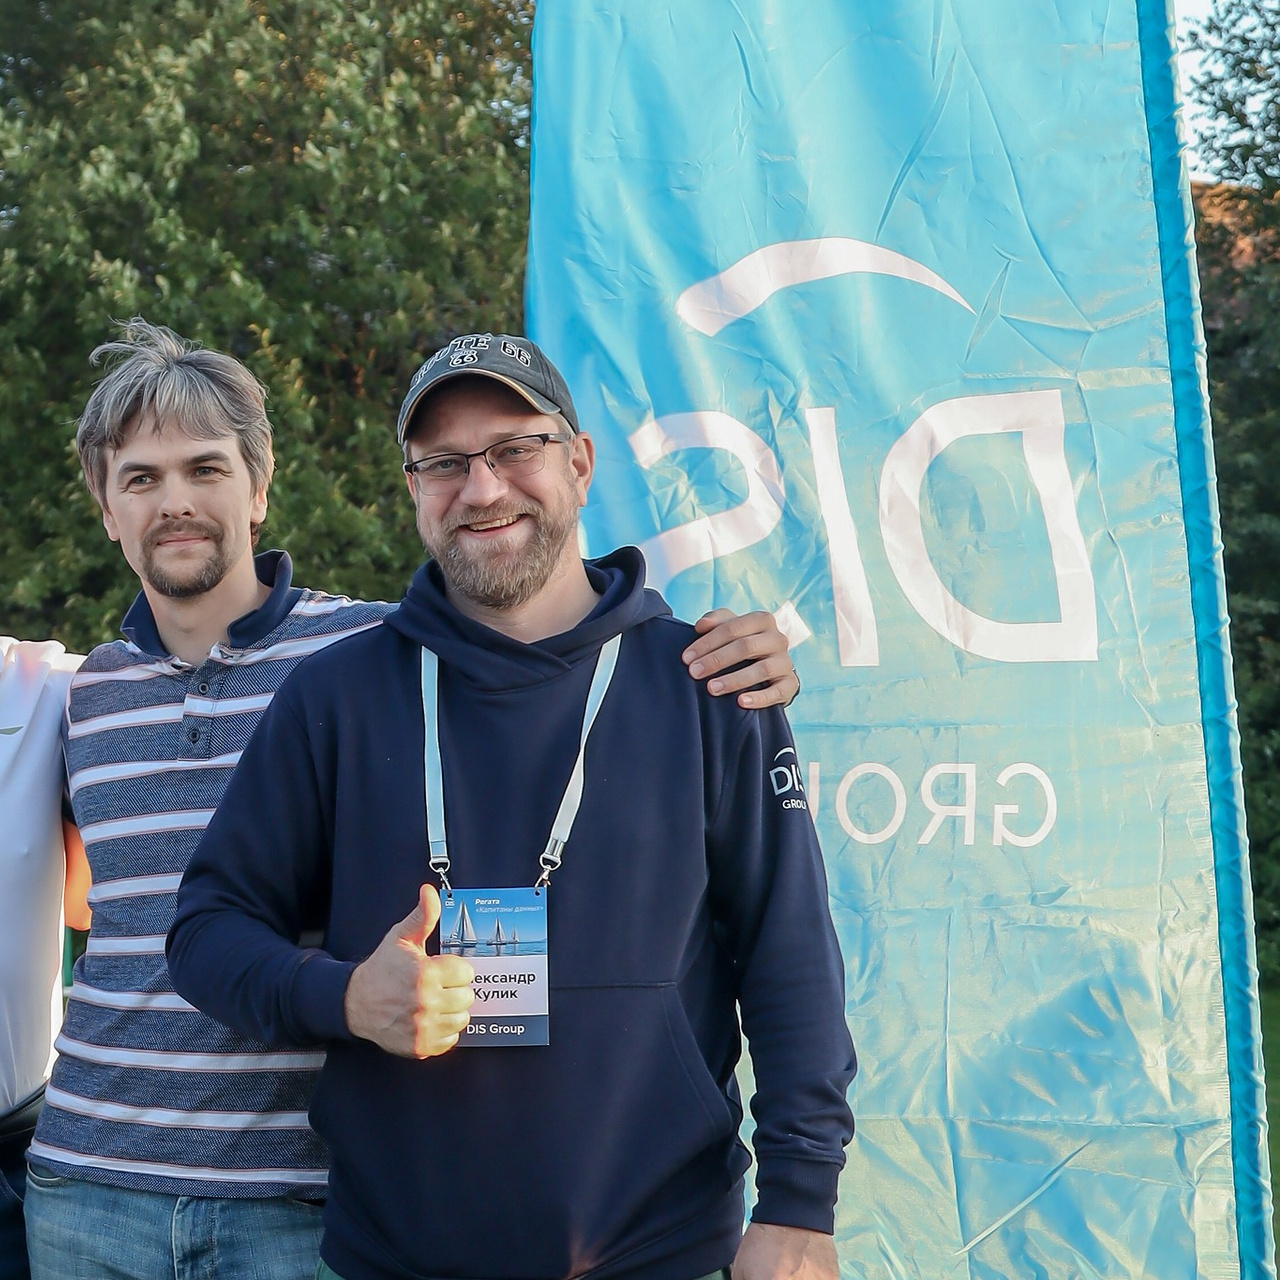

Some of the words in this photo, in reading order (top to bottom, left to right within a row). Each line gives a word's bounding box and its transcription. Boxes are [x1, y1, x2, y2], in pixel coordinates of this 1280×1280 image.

[453, 354, 474, 365] 66
[500, 340, 532, 367] 66
[782, 799, 807, 810] GROU
[470, 971, 536, 985] ександр
[473, 988, 518, 1002] Кулик
[466, 1024, 487, 1035] DIS
[489, 1024, 525, 1036] Group
